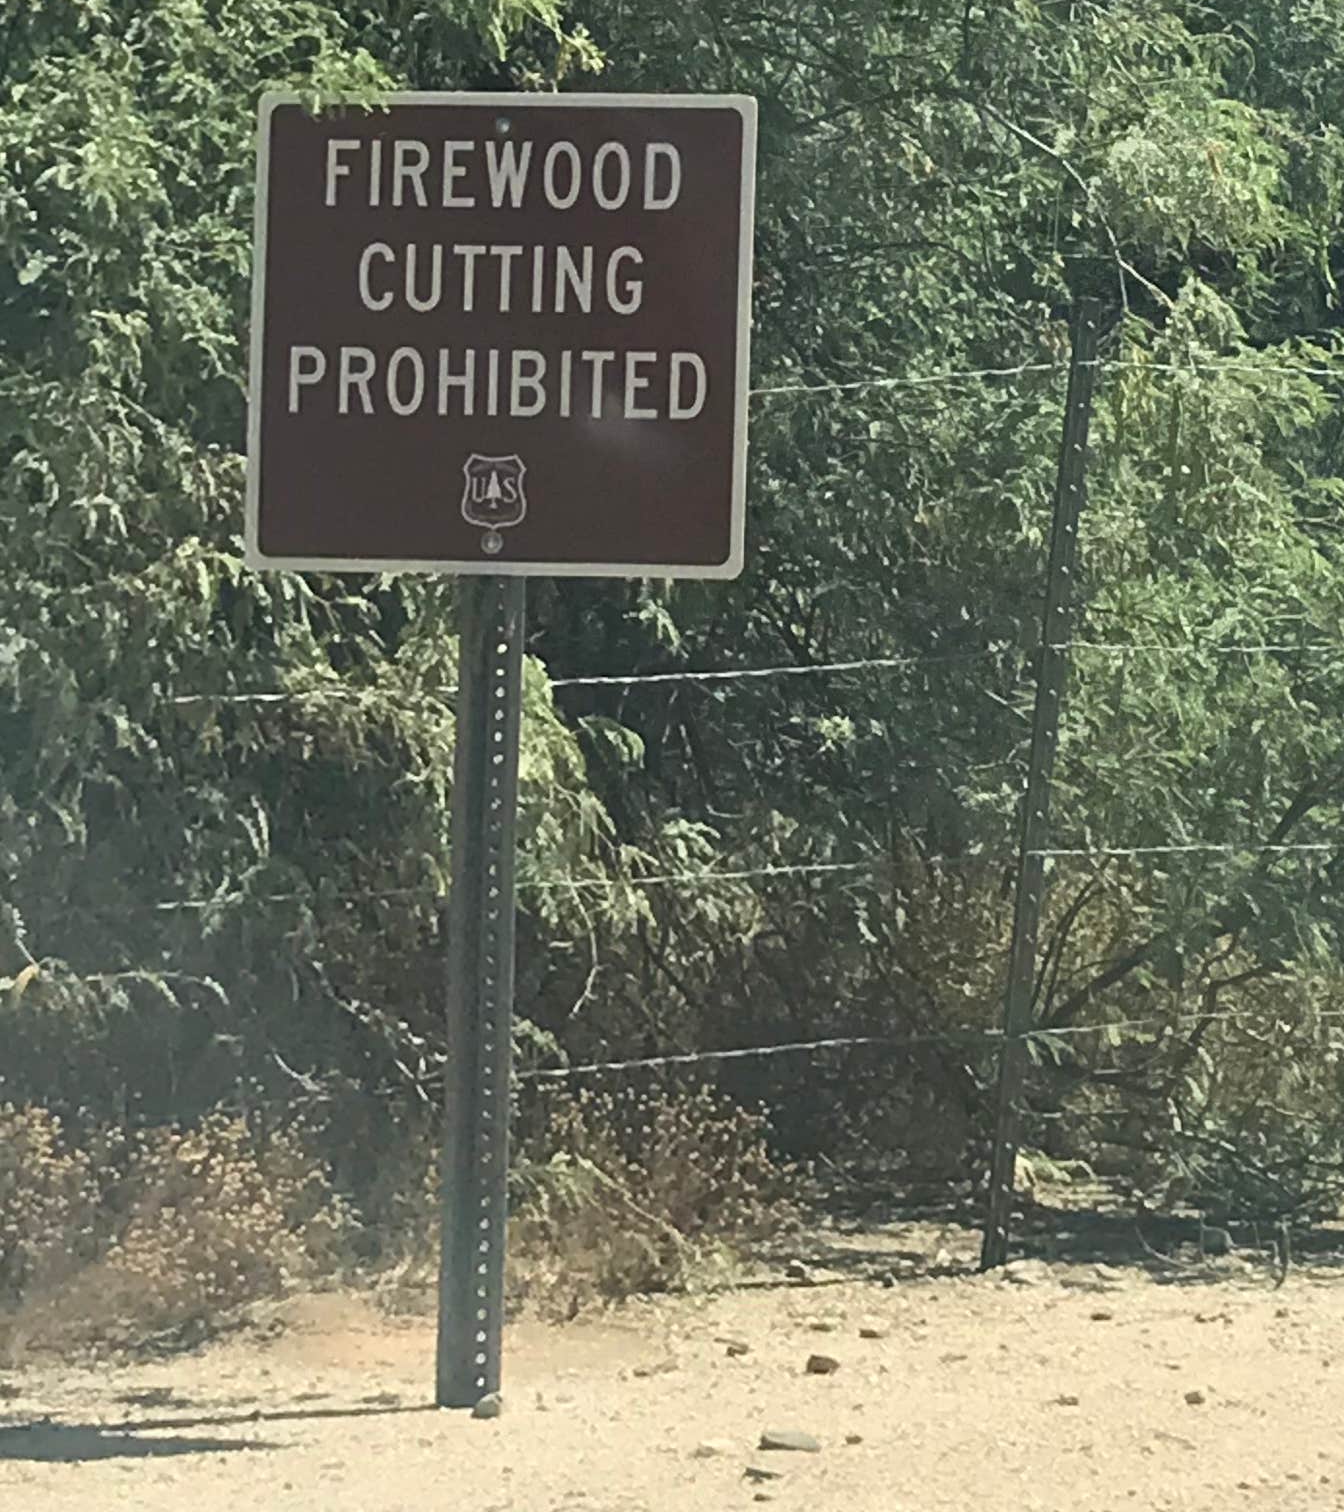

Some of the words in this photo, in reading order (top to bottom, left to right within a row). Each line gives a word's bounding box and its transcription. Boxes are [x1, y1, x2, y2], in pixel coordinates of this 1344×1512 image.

[324, 138, 682, 211] FIREWOOD
[358, 242, 644, 315] CUTTING
[288, 345, 708, 420] PROHIBITED
